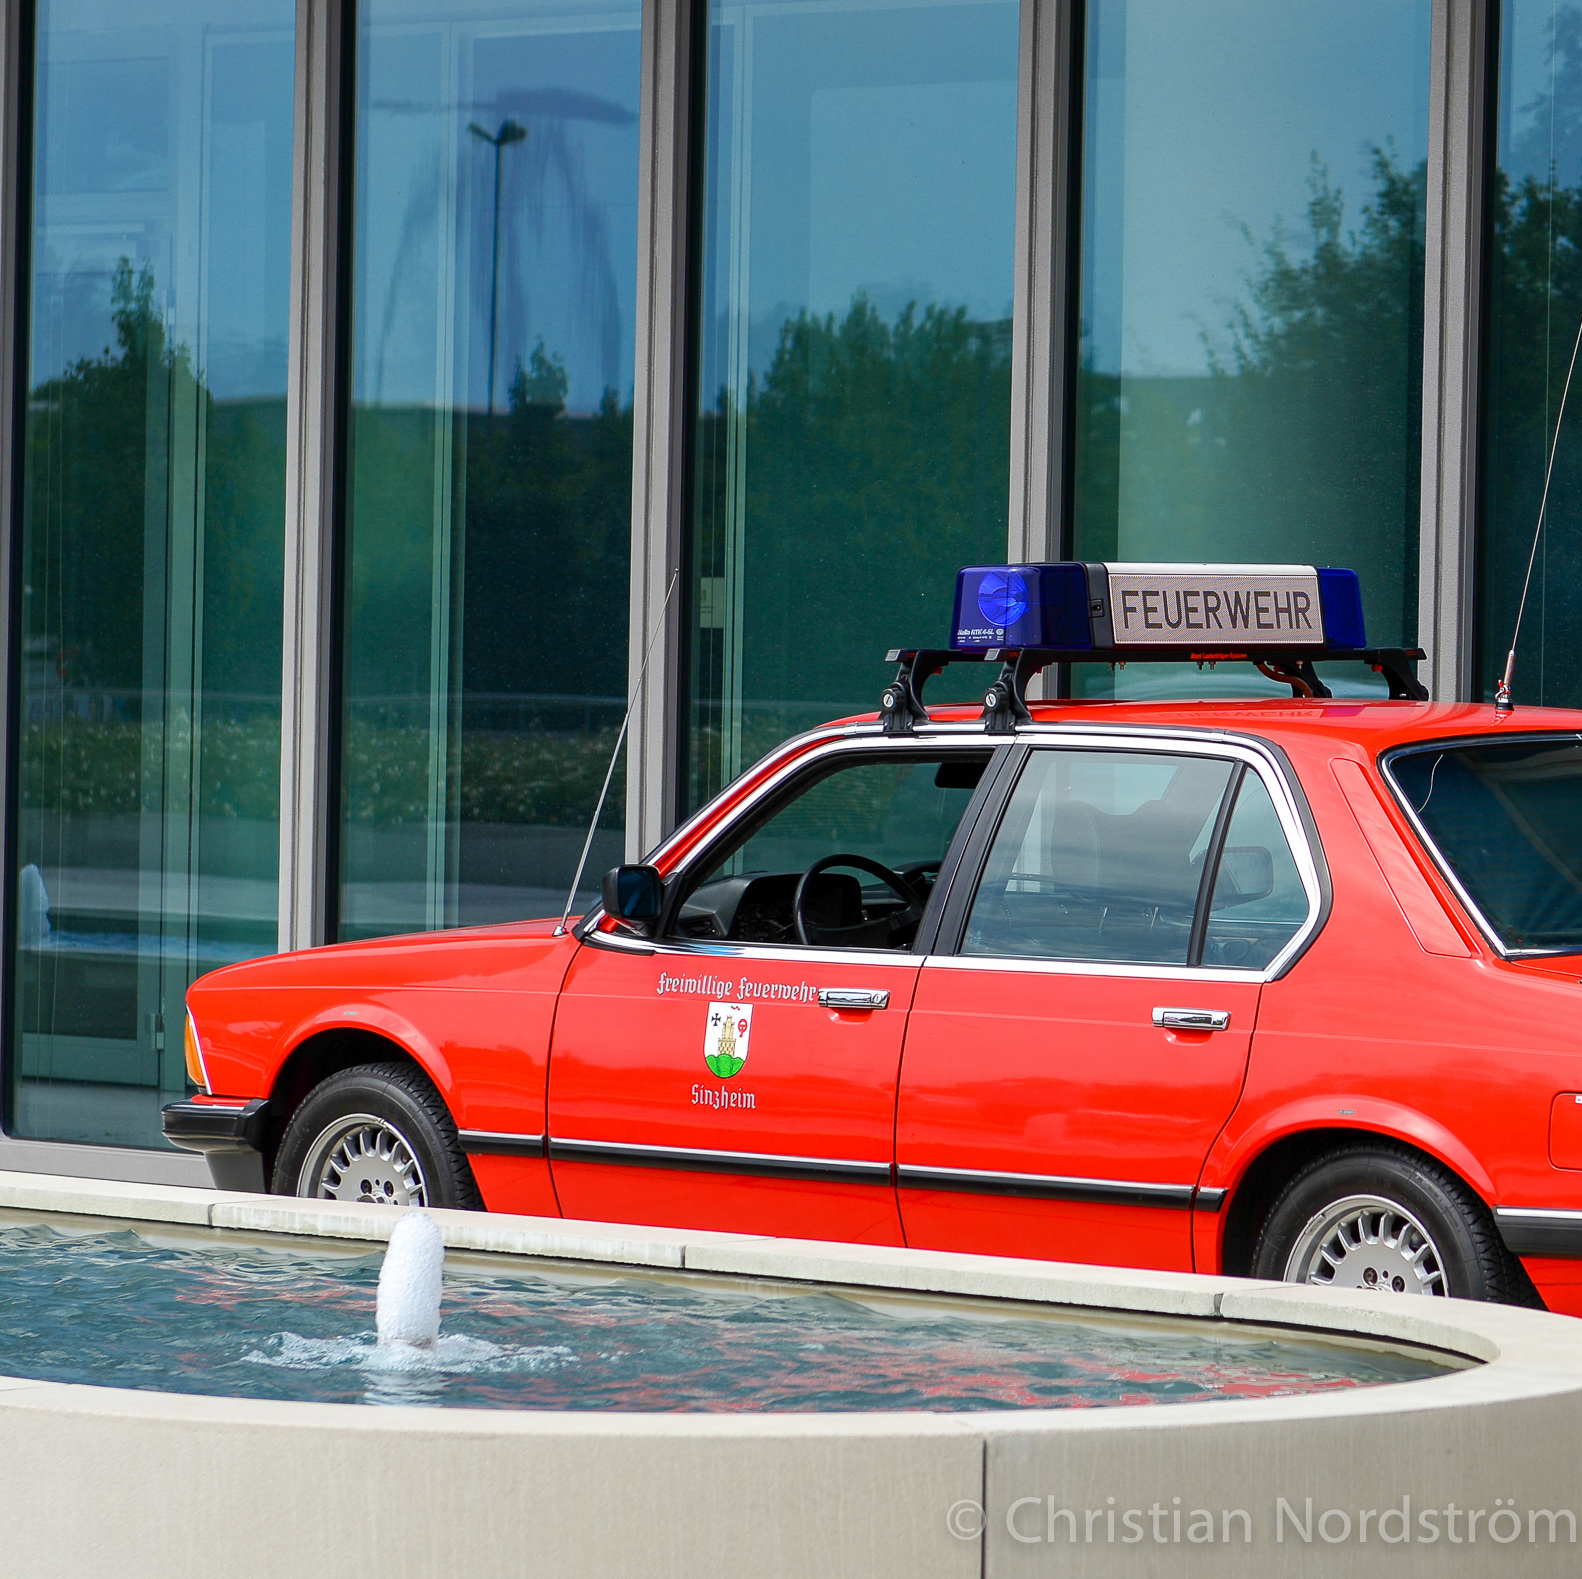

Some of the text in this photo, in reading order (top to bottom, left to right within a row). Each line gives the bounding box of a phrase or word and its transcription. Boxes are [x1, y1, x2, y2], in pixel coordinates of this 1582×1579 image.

[1121, 590, 1313, 629] FEUERWEHR
[656, 971, 818, 1003] Freiwillige Feuerwehr
[691, 1084, 756, 1110] Sinzheim
